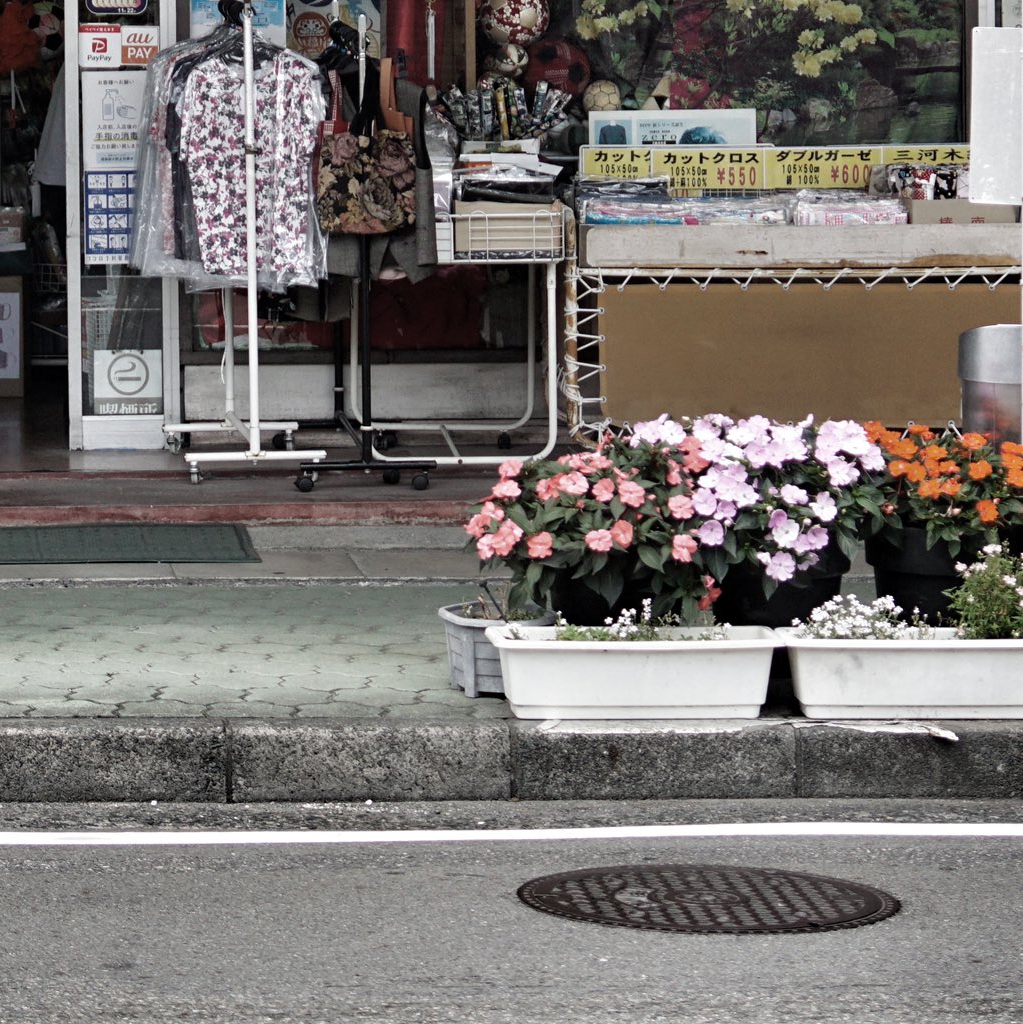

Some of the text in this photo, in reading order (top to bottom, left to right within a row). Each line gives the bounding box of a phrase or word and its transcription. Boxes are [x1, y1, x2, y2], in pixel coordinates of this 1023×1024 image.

[126, 33, 153, 44] au
[127, 47, 152, 59] PAY
[95, 132, 138, 141] 手指の消毒
[664, 152, 759, 165] カットクロス
[777, 150, 872, 162] ダブルガーゼ
[893, 149, 970, 162] 三河木
[717, 166, 757, 186] ¥550
[831, 164, 871, 184] ¥600
